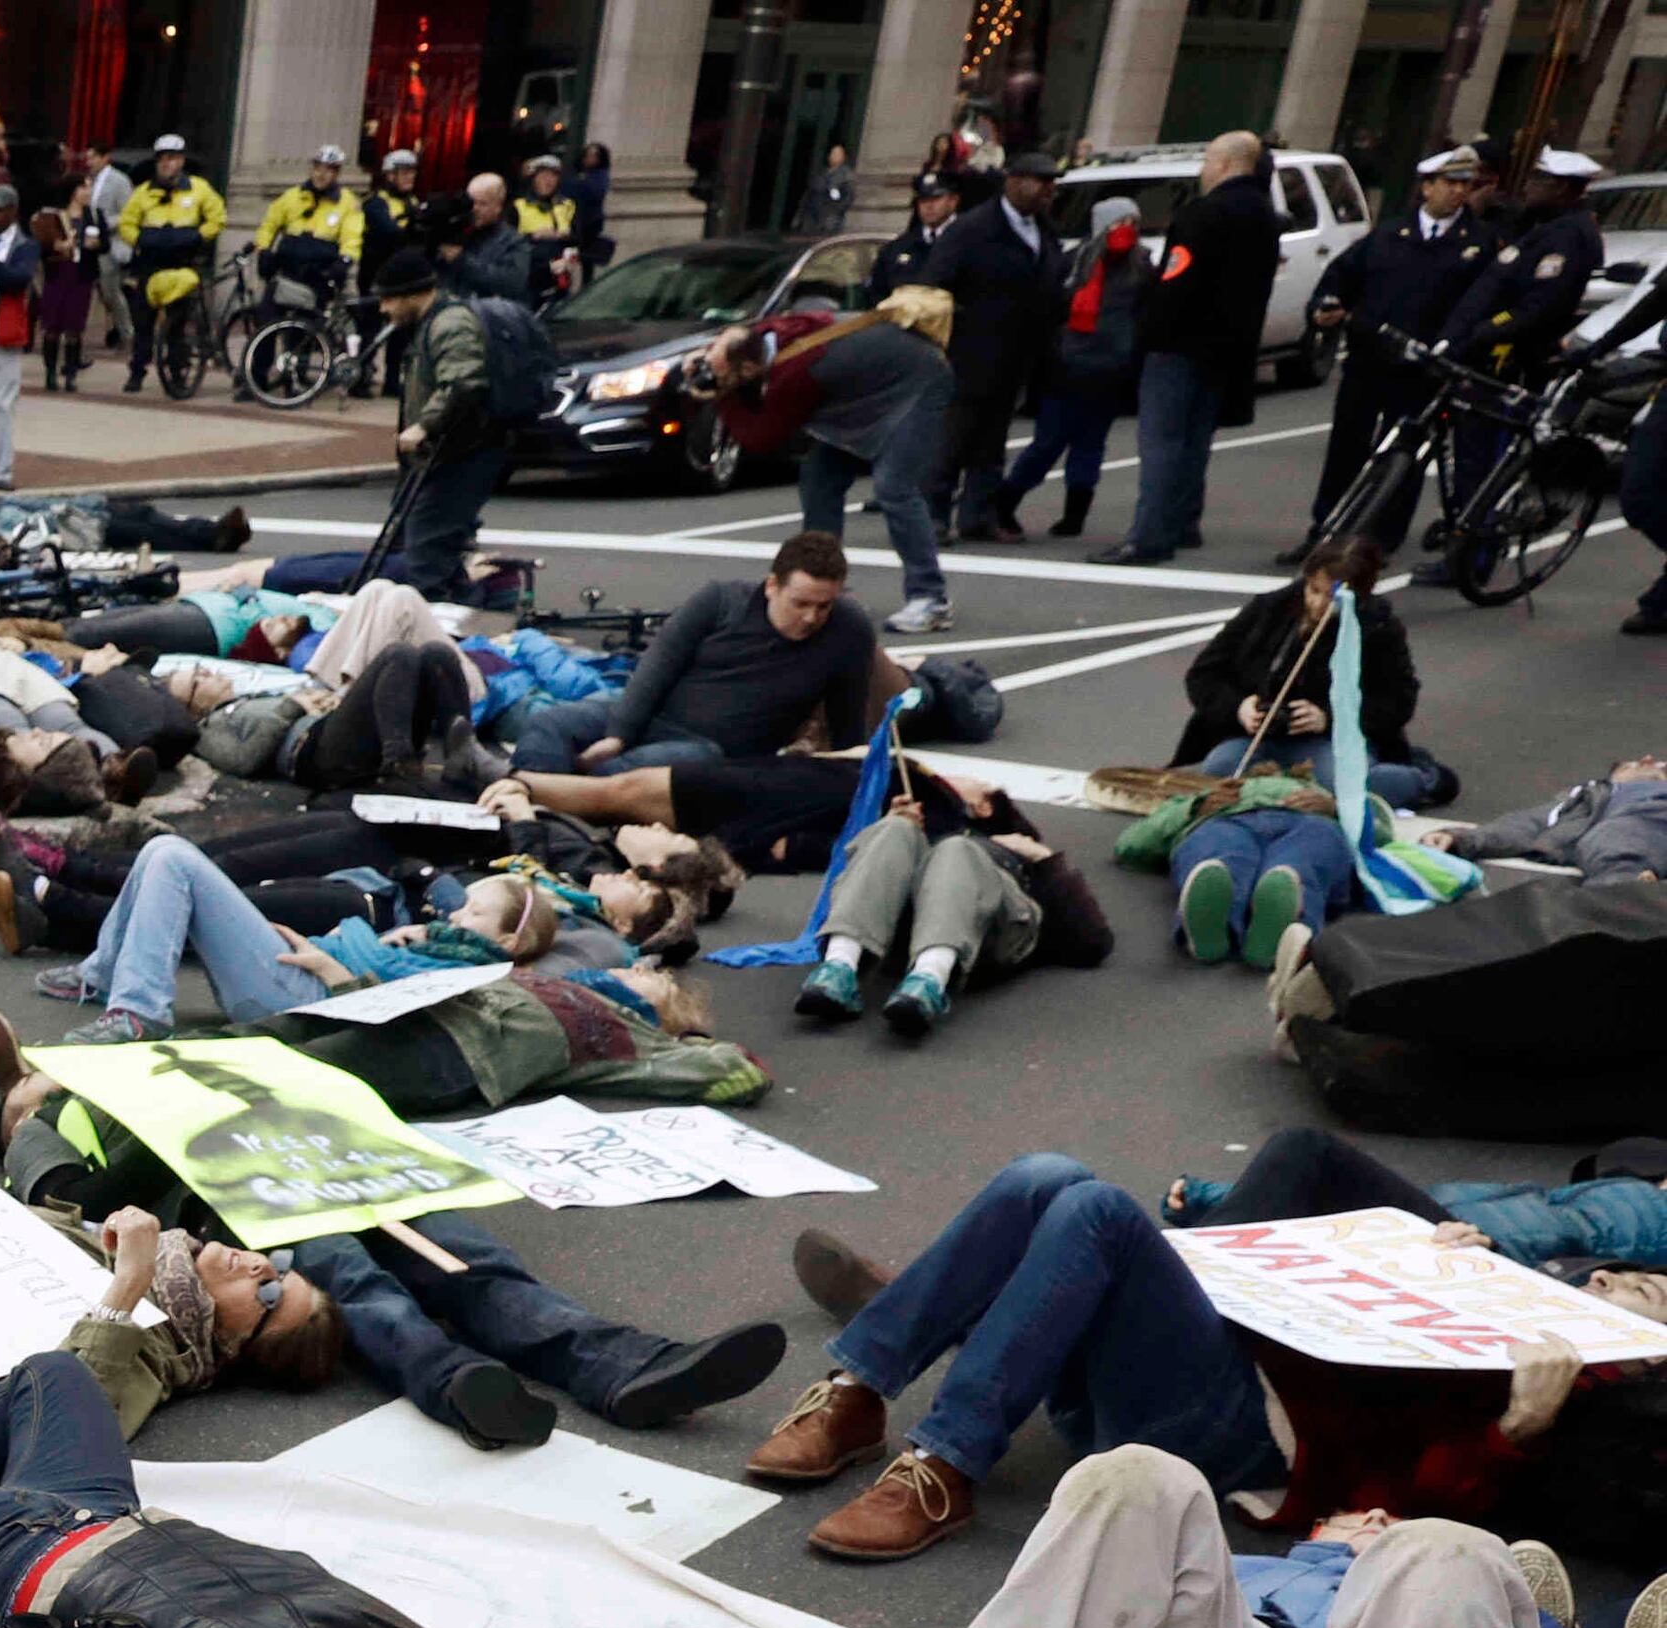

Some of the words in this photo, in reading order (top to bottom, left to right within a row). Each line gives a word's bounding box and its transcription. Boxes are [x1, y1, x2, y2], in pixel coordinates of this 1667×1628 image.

[452, 1121, 554, 1170] WATER
[540, 1146, 617, 1180] ALL
[563, 1124, 709, 1190] PROTECT
[1192, 1226, 1531, 1357] NATIVE
